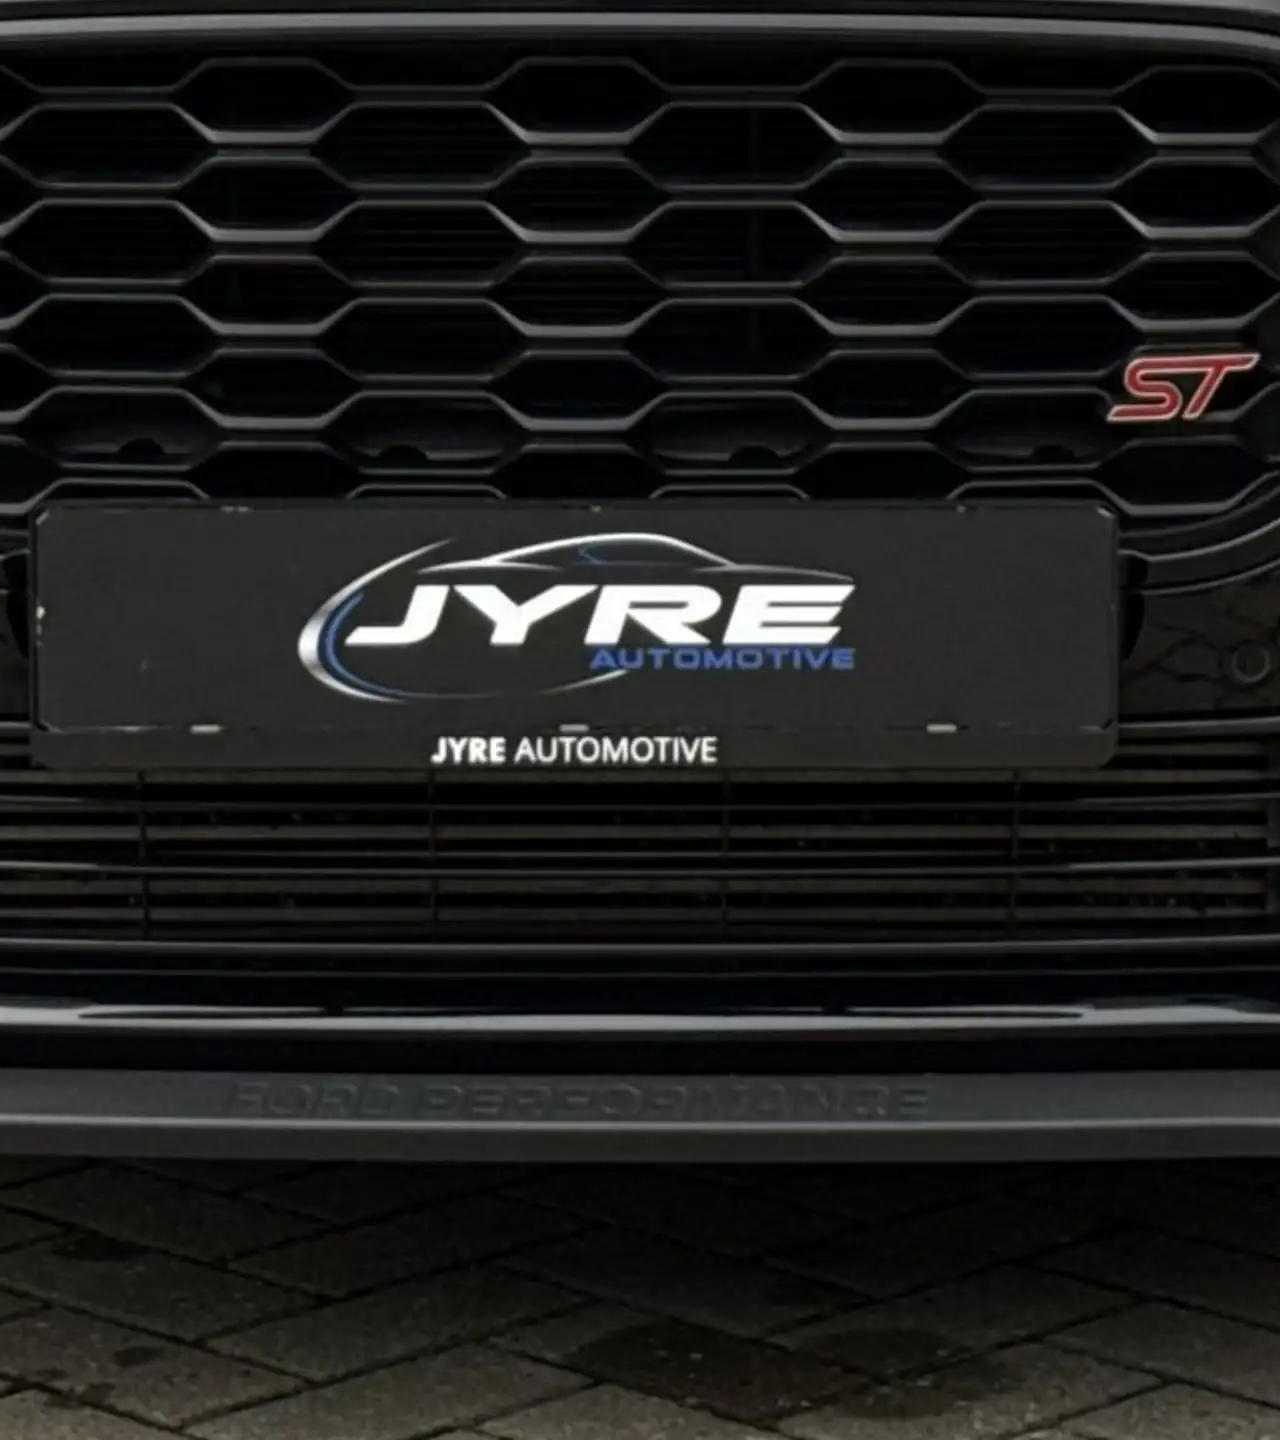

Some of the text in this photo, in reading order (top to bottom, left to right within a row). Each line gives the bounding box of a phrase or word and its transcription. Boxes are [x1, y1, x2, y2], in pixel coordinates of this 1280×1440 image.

[1106, 352, 1261, 422] ST
[344, 584, 856, 646] JYRE
[589, 647, 856, 670] AUTOMOTIVE
[431, 735, 719, 764] JYRE AUTOMOTIVE
